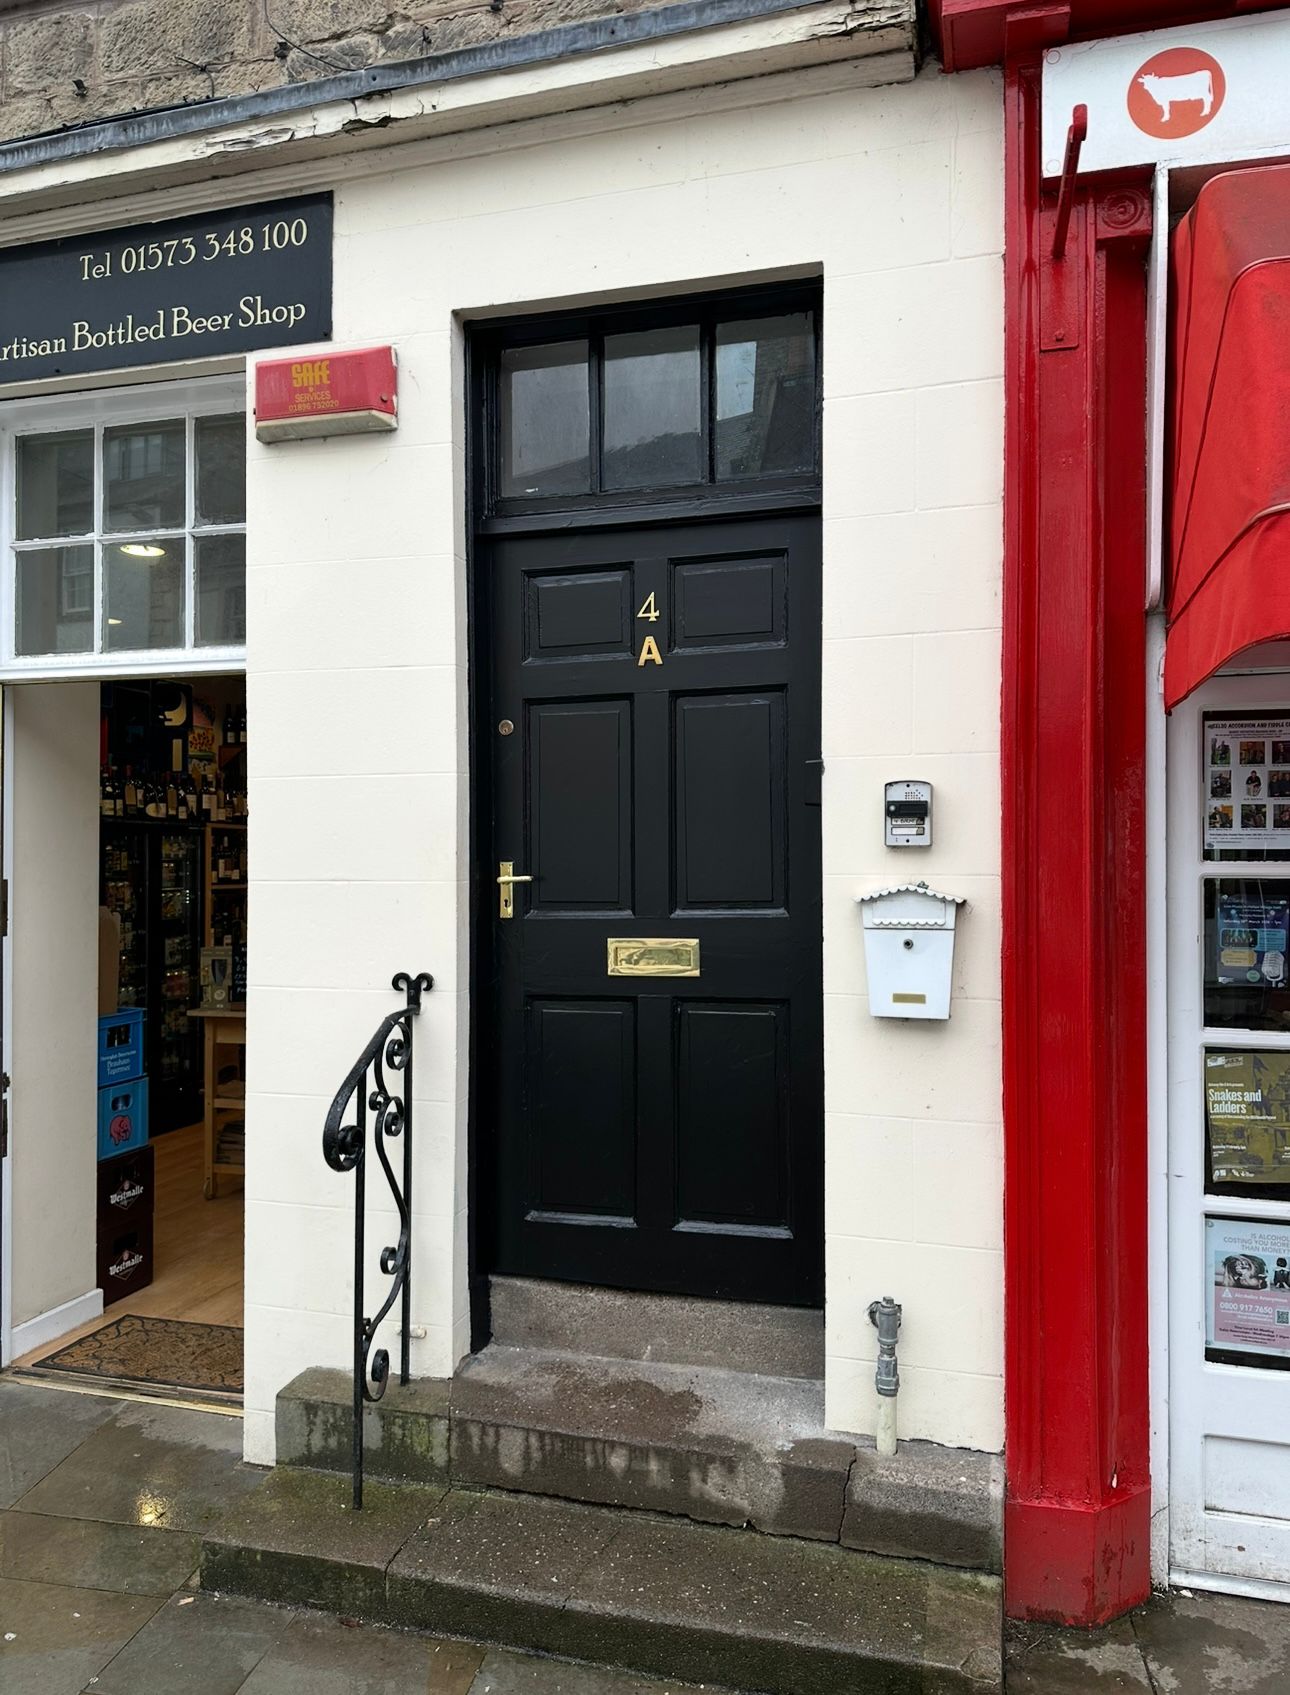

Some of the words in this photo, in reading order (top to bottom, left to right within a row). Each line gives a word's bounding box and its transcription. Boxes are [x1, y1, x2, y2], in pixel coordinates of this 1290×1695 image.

[80, 253, 111, 280] Tel
[121, 237, 196, 274] 01573
[203, 227, 254, 261] 348
[262, 218, 308, 252] 100
[0, 334, 66, 362] rtisan
[73, 311, 165, 351] Bottled
[171, 306, 233, 338] Beer
[238, 296, 306, 329] Shop
[291, 360, 330, 388] SAFE
[294, 390, 331, 403] SERVICES
[636, 591, 660, 622] 4
[637, 635, 663, 666] A
[1208, 1088, 1243, 1102] Snakes
[1244, 1089, 1262, 1102] and
[1209, 1101, 1247, 1114] Ladders
[110, 1185, 144, 1204] Westmalle
[1223, 1236, 1253, 1245] COSTING
[1258, 1233, 1289, 1242] ALCOHOL
[1241, 1244, 1260, 1252] THAN
[109, 1254, 143, 1276] Westmalle
[1219, 1302, 1238, 1310] 0800
[1239, 1303, 1254, 1311] 917
[1254, 1305, 1273, 1314] 7650
